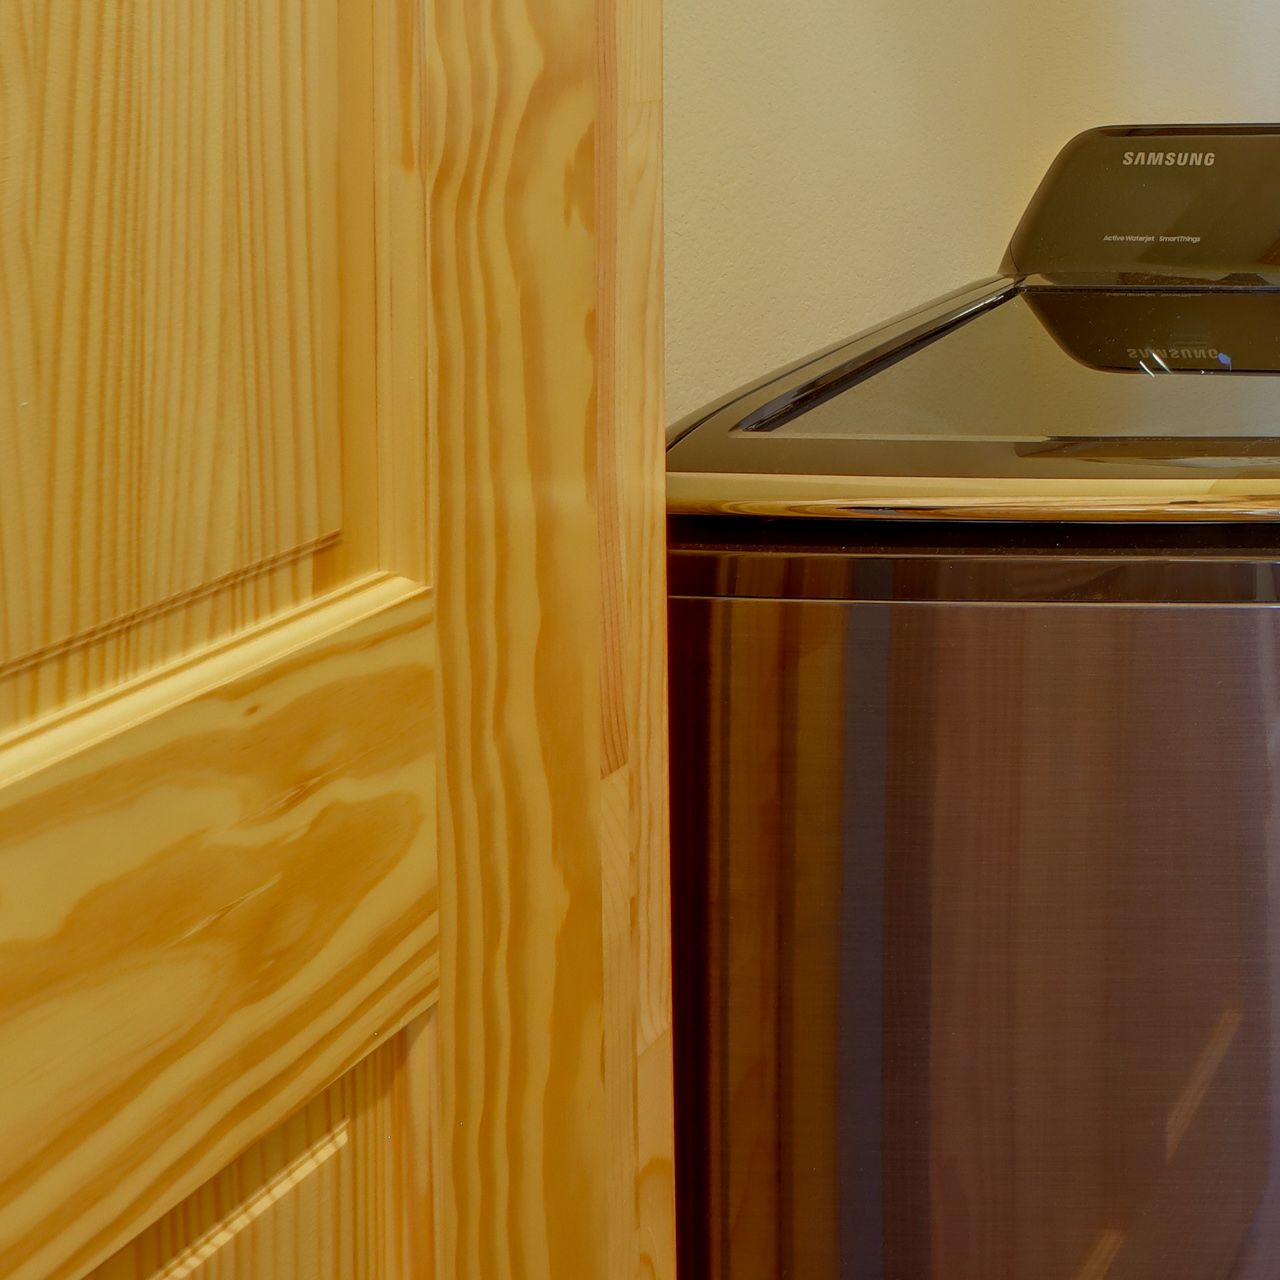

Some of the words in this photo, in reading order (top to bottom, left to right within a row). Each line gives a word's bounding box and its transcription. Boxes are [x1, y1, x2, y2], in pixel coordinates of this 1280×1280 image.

[1122, 151, 1215, 166] SAMSUNG
[1125, 235, 1155, 243] Waterjet
[1159, 235, 1200, 243] SmartThings
